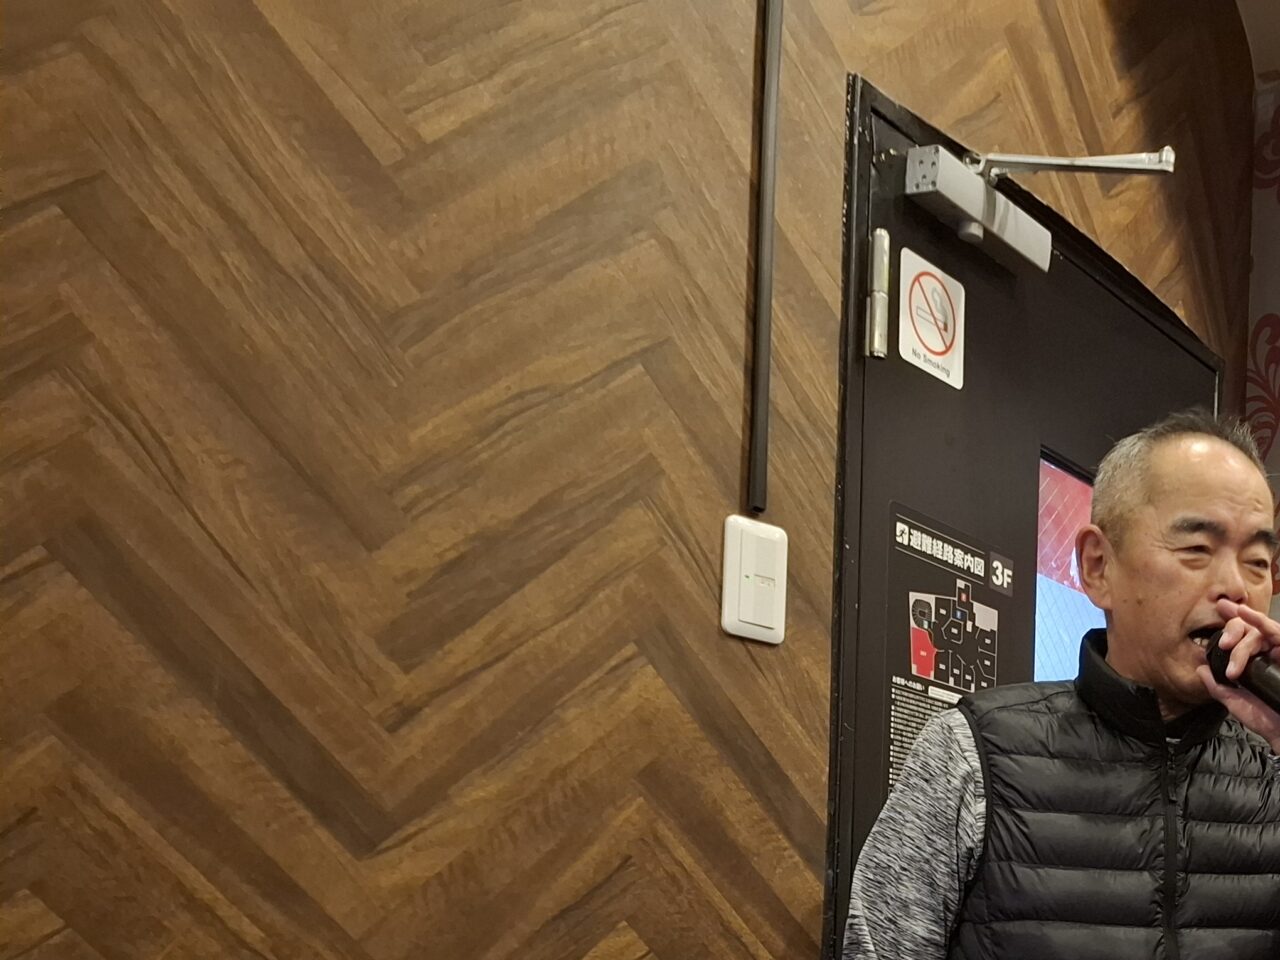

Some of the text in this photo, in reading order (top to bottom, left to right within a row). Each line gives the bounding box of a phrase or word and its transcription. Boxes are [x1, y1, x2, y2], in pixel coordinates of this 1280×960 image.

[912, 348, 921, 359] No
[909, 528, 985, 577] 避難経路案内図
[991, 560, 1013, 588] 3F
